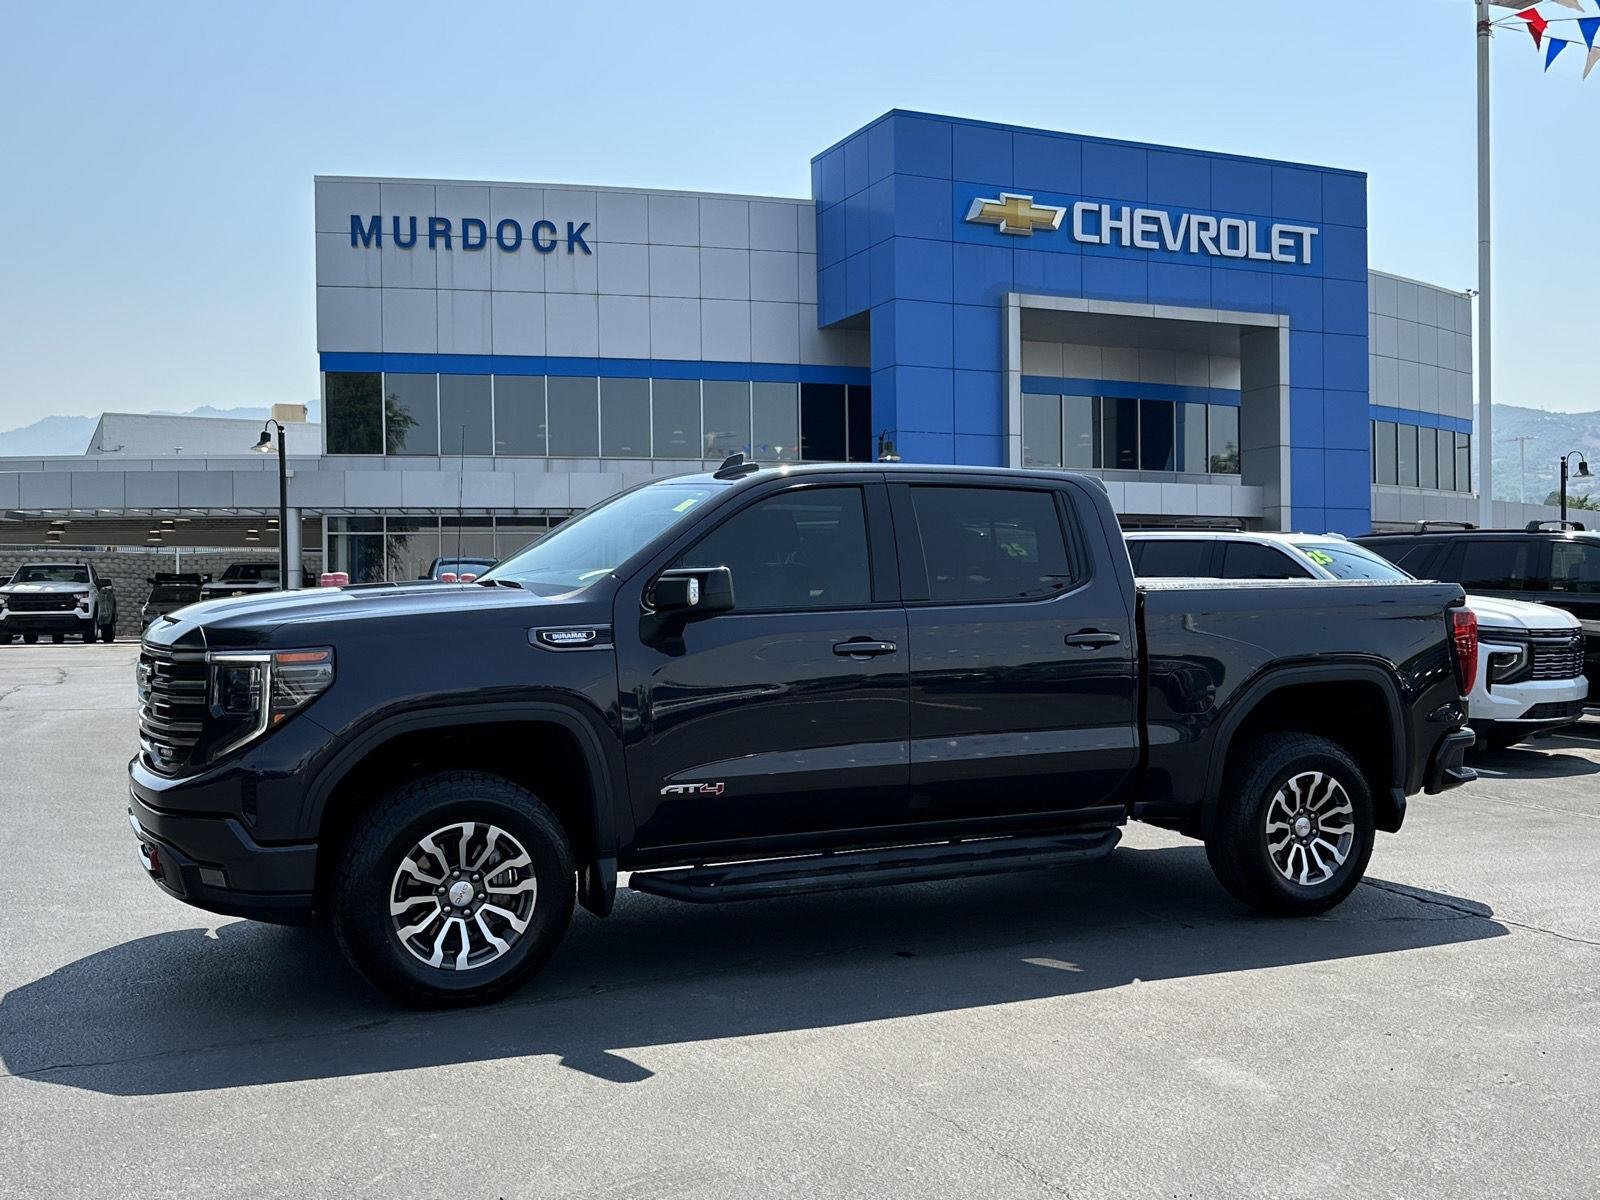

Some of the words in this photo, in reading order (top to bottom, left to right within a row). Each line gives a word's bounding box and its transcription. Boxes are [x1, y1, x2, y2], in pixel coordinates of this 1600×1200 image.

[350, 214, 592, 255] MURDOCK
[1073, 201, 1319, 264] CHEVROLET
[660, 782, 725, 795] AT4
